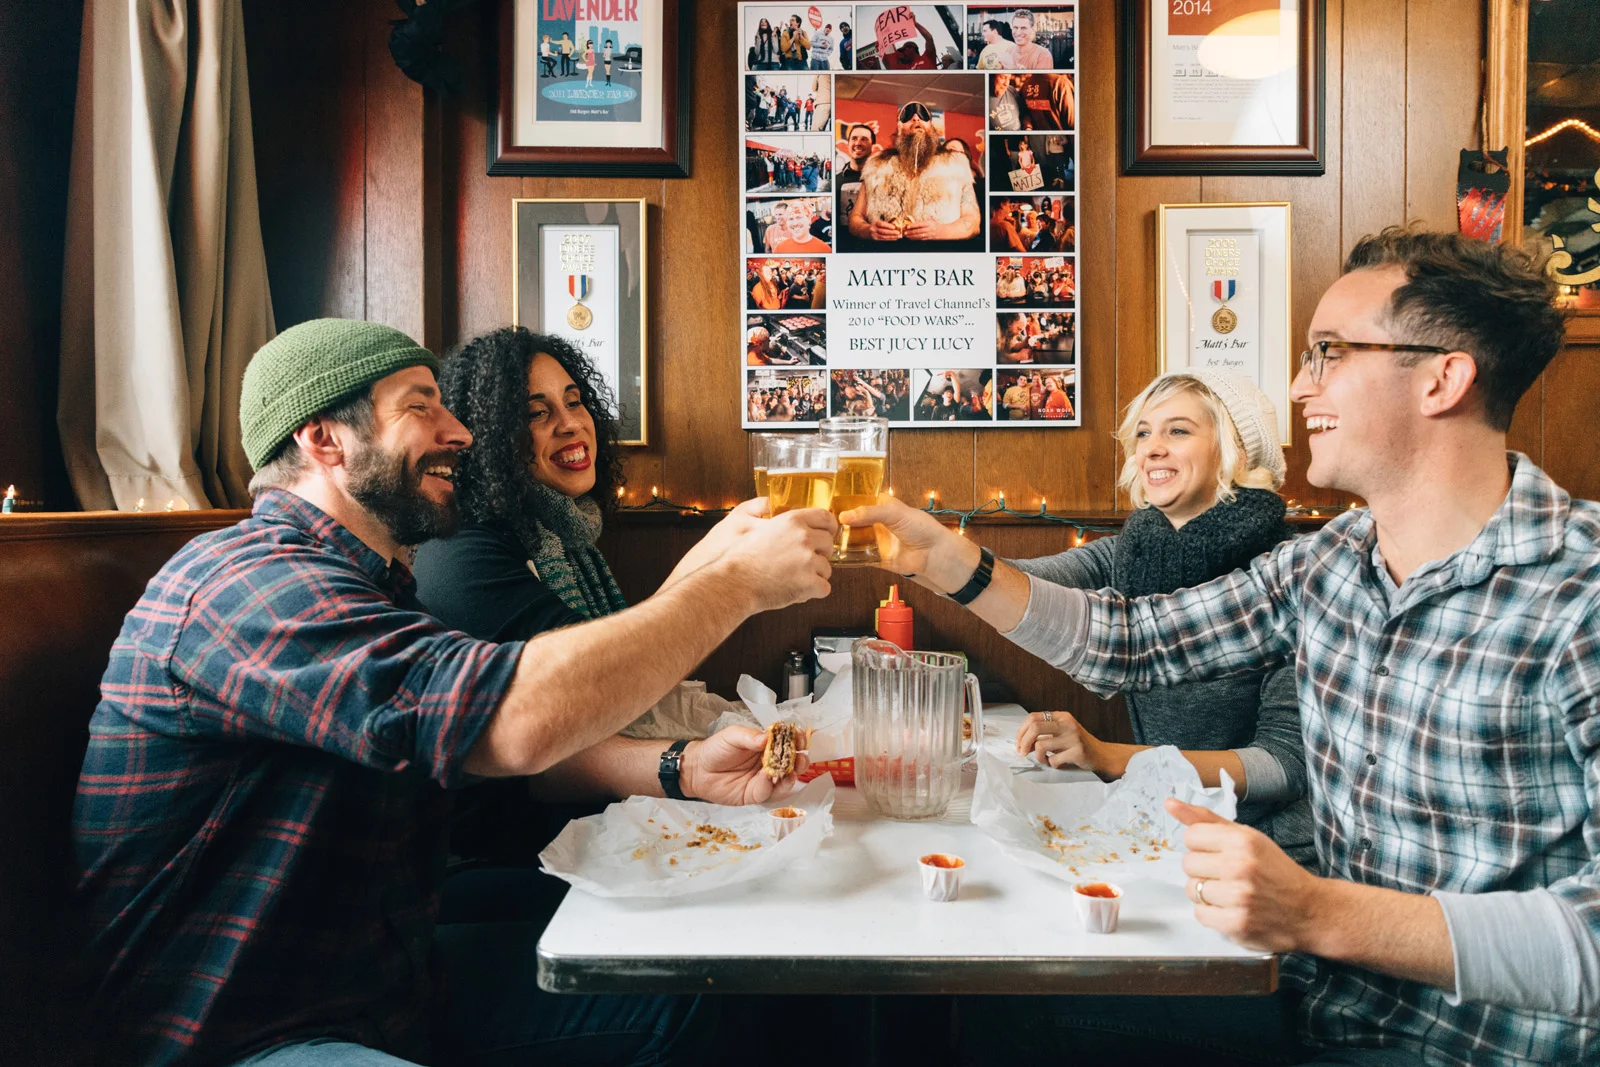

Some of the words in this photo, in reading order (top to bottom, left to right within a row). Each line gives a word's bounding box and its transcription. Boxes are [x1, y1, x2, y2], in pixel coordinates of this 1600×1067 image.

[543, 0, 638, 21] LAVENDER
[1173, 0, 1212, 15] 2014
[1204, 247, 1241, 258] DINERS
[1204, 257, 1240, 267] CHOICE
[847, 268, 927, 286] MATT’S
[934, 269, 975, 286] BAR
[1205, 267, 1239, 276] AWARD
[833, 299, 876, 309] Winner
[879, 298, 891, 309] of
[895, 298, 930, 309] Travel
[933, 298, 991, 309] Channel’s
[848, 317, 875, 327] 2010
[878, 315, 921, 326] “FOOD
[850, 338, 885, 351] BEST
[887, 337, 928, 354] JUCY
[933, 337, 974, 351] LUCY
[1196, 338, 1228, 350] Matt's
[1230, 339, 1249, 349] Bar
[1206, 358, 1219, 366] Best
